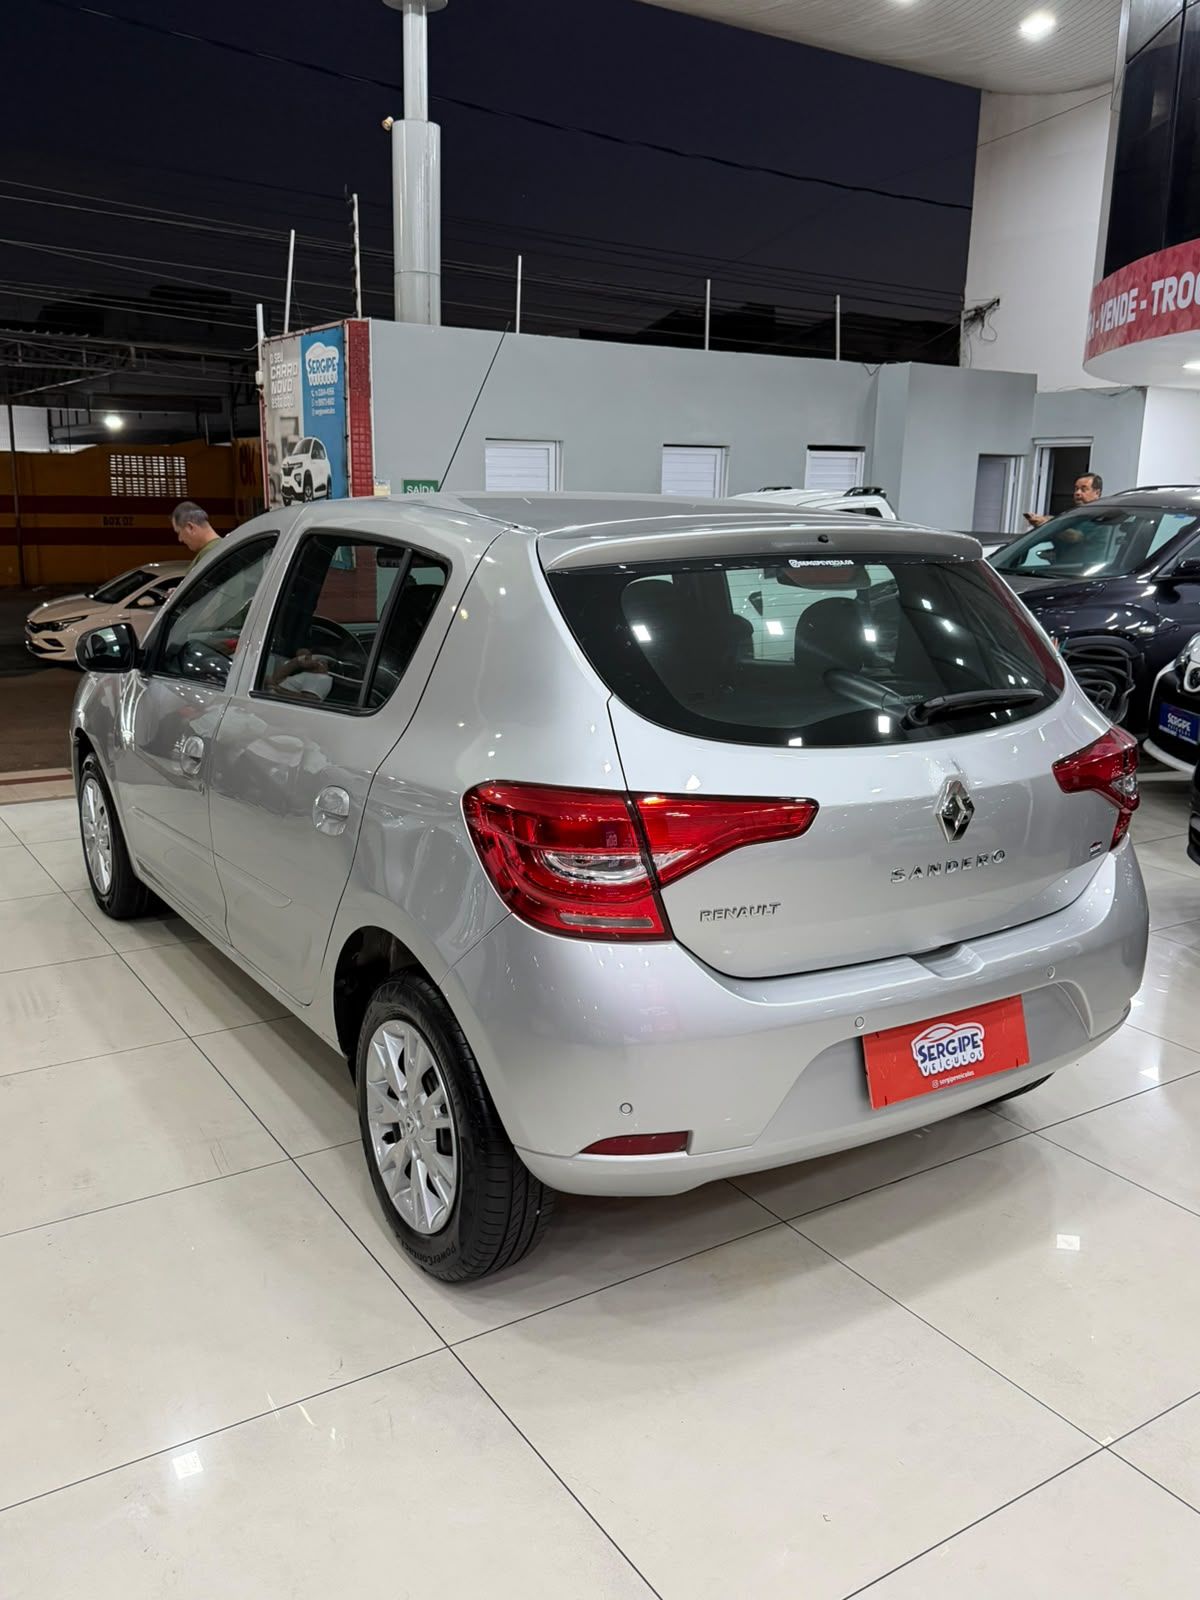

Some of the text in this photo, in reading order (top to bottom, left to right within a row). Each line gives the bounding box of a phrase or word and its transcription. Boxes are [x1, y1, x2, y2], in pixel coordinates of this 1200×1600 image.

[1100, 288, 1138, 334] VENDE
[270, 362, 297, 379] CARRO
[308, 356, 337, 375] SERGIPE
[271, 379, 293, 394] NOVO
[406, 483, 435, 495] SAÍDA
[890, 849, 1006, 884] SANDERO
[699, 902, 781, 922] RENAULT
[917, 1032, 981, 1065] SERGIPE
